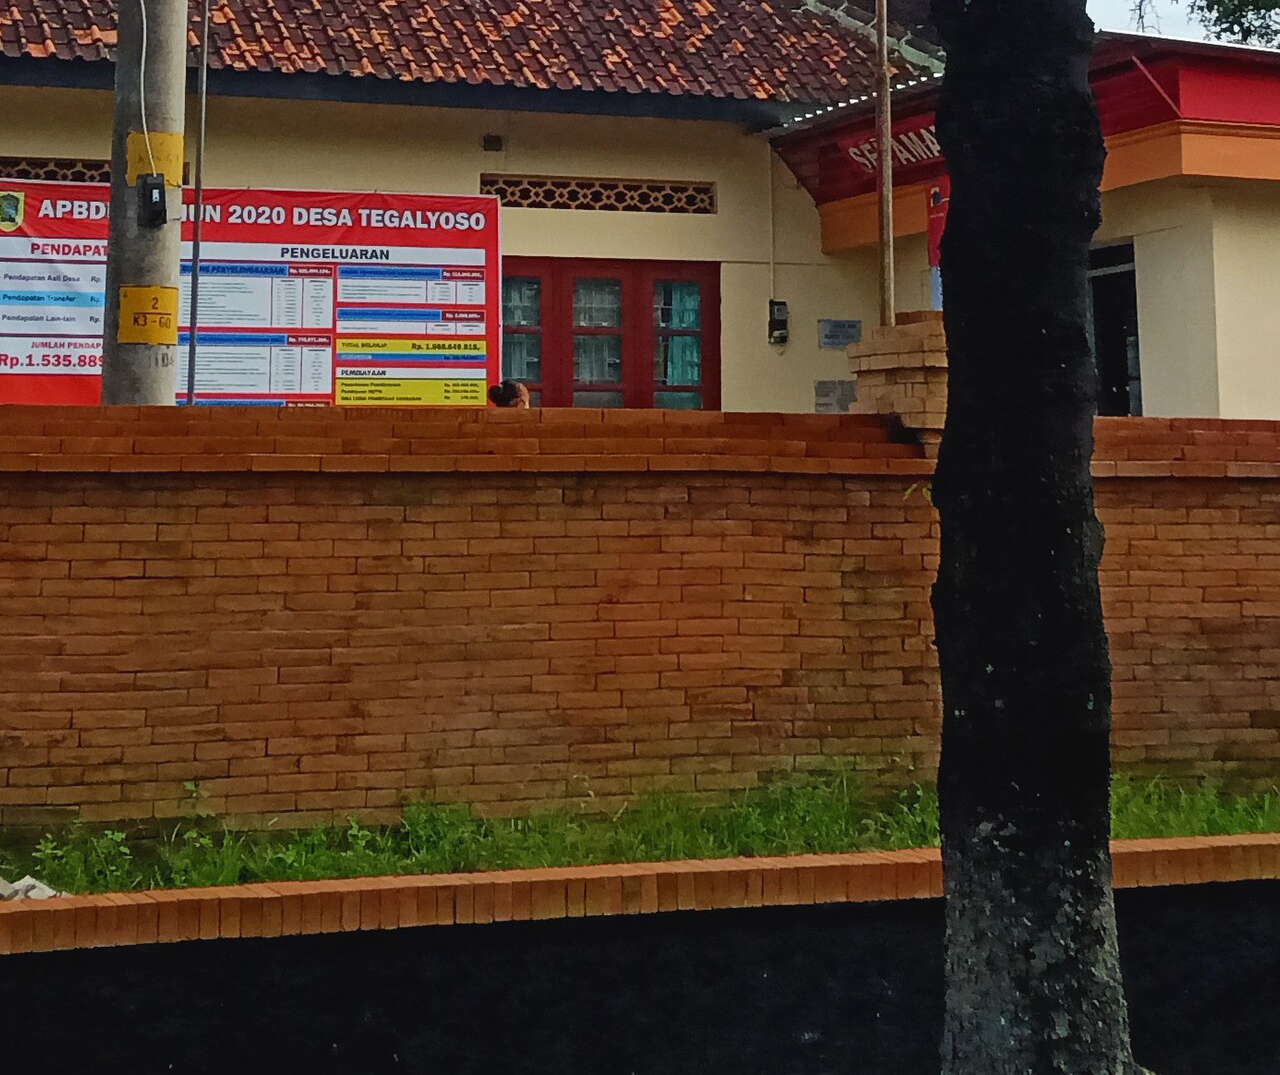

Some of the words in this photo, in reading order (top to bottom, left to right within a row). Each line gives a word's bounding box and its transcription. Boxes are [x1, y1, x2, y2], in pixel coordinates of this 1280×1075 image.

[38, 199, 110, 220] APBD
[228, 206, 286, 225] 2020
[292, 209, 352, 227] DESA
[358, 209, 486, 231] TEGALYOSO
[280, 247, 390, 261] PENGELUARAN
[151, 296, 159, 310] 2
[31, 341, 65, 349] JUMLAH
